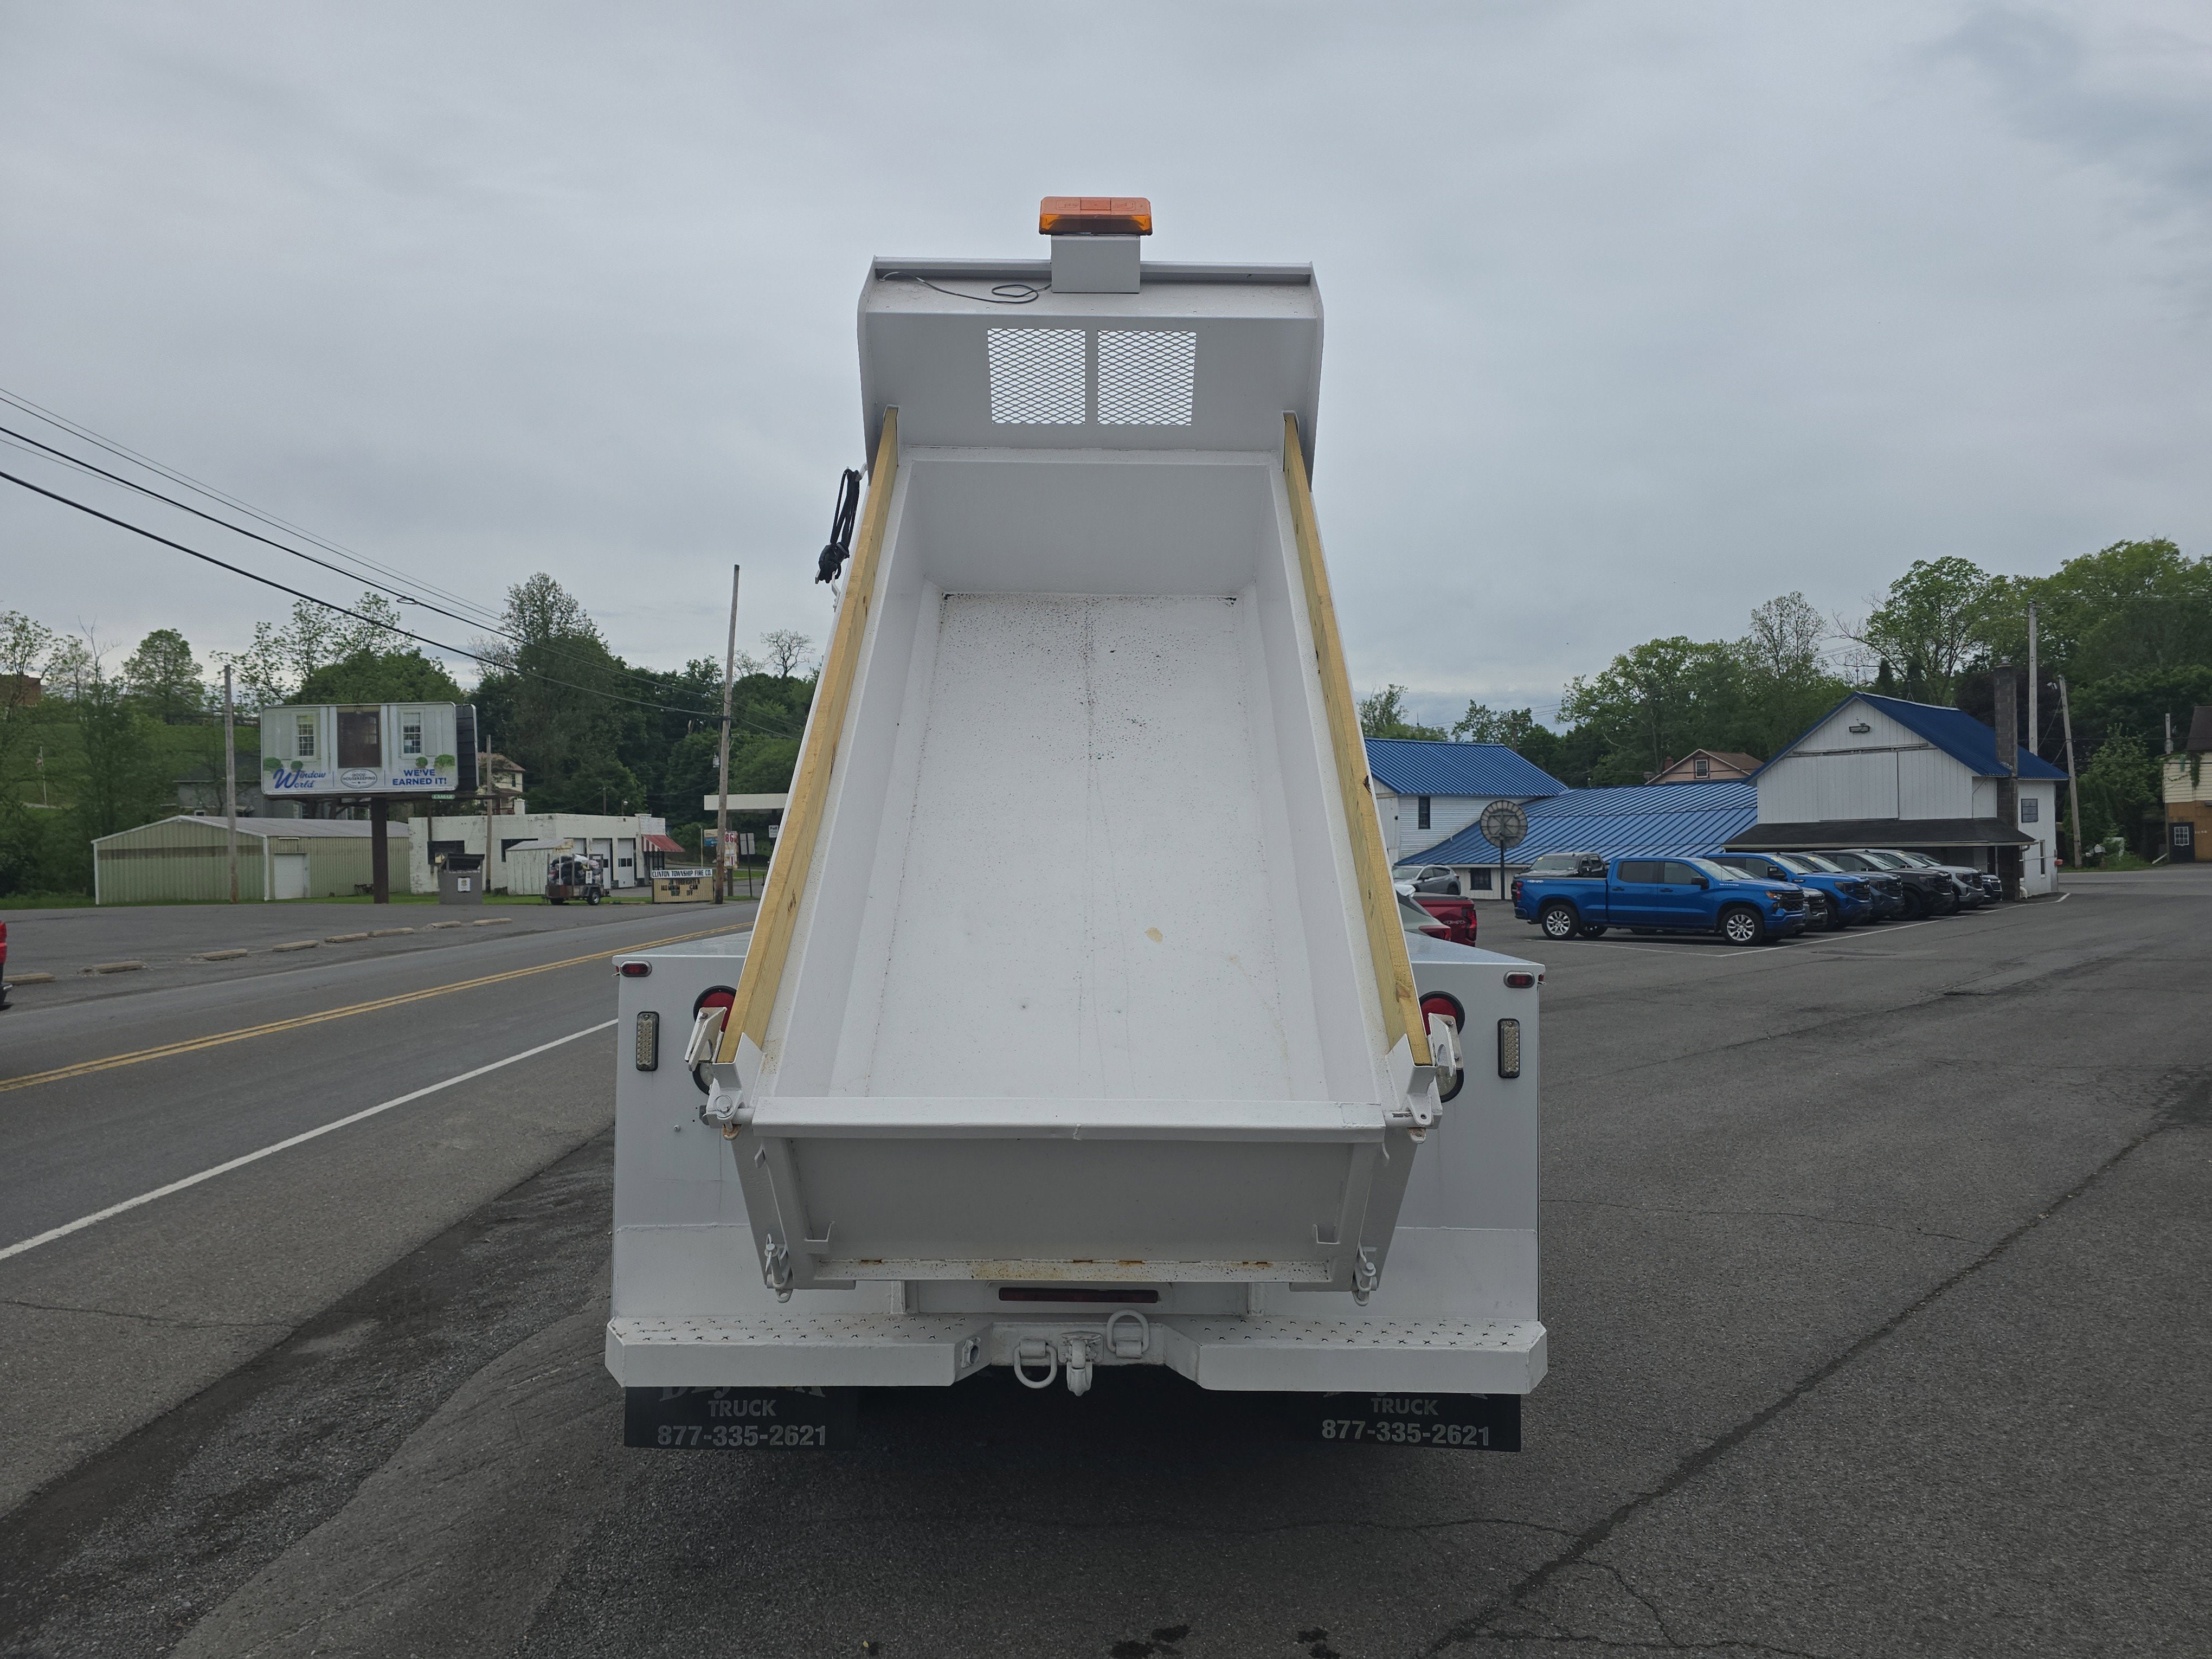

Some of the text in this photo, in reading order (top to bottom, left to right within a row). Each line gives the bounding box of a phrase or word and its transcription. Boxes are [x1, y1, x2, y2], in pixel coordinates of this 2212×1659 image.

[273, 768, 326, 789] Window
[392, 777, 432, 786] EARNED
[708, 1399, 777, 1417] TRUCK
[1371, 1398, 1439, 1416] TRUCK
[657, 1424, 826, 1446] 877-335-2621
[1322, 1419, 1489, 1446] 877-335-2621
